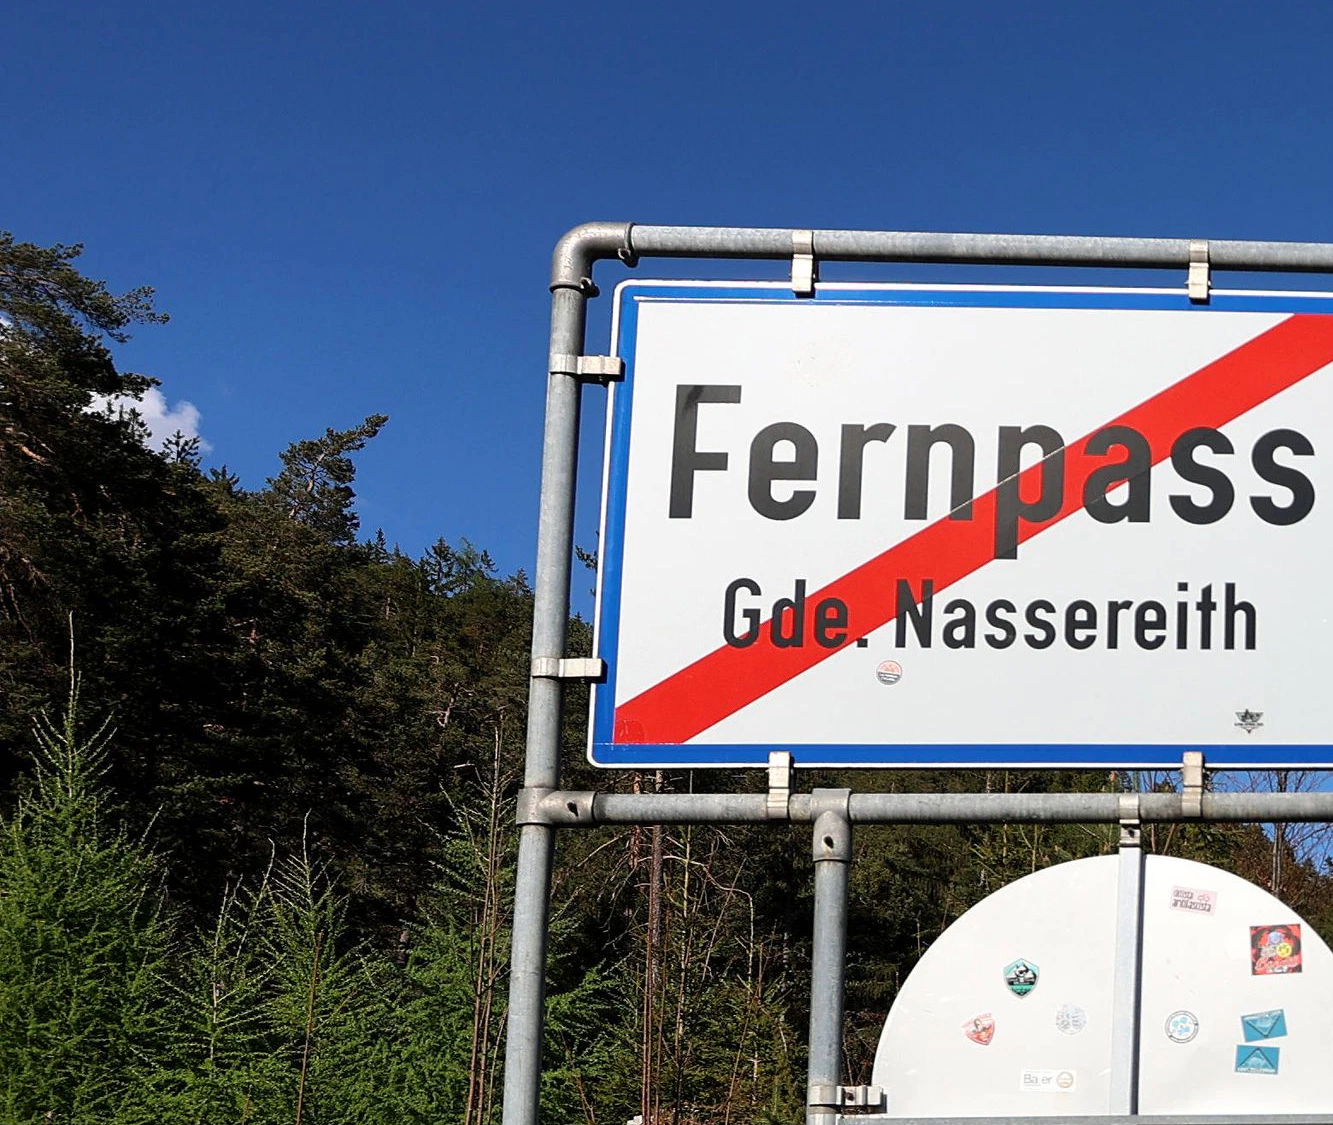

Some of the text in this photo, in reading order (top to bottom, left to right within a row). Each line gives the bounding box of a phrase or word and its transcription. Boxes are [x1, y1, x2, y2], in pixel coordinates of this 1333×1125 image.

[669, 383, 1316, 560] Fernpass
[724, 578, 1257, 651] Gde. Nassereith
